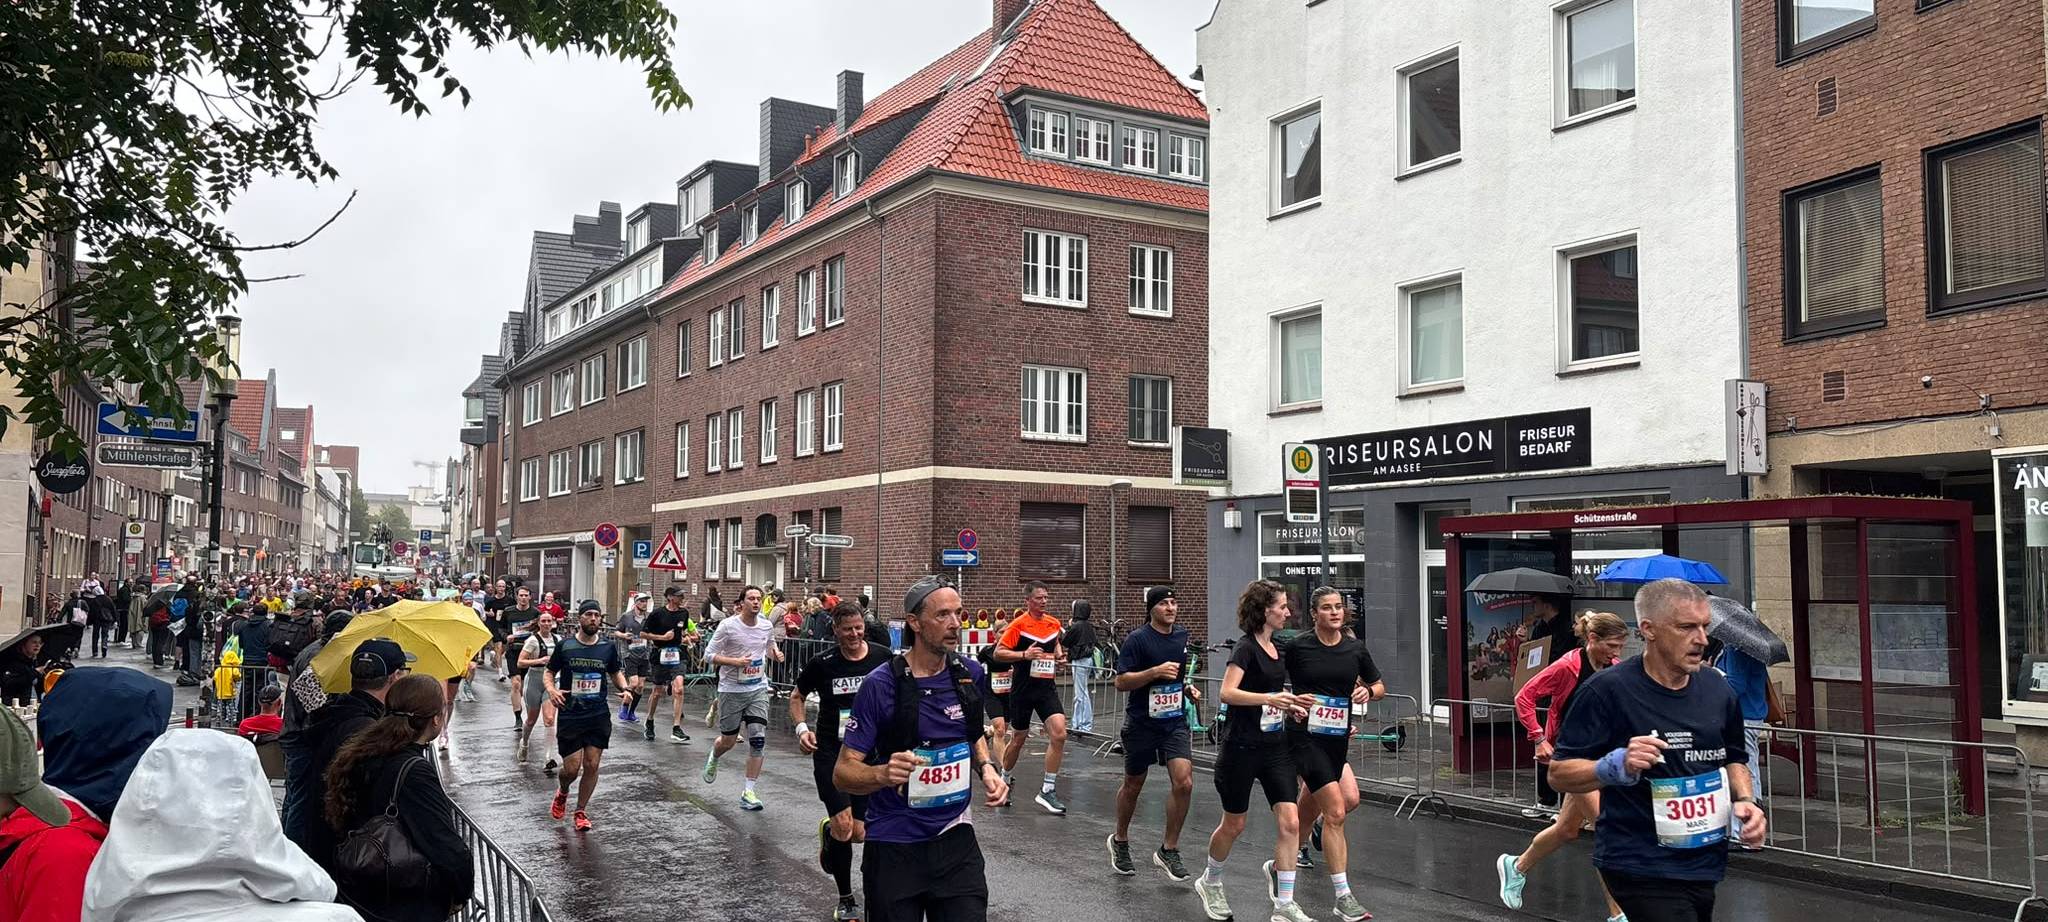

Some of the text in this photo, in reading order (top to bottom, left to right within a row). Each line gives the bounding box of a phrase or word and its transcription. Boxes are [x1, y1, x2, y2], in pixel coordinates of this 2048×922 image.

[1519, 425, 1576, 441] FRISEUR
[1327, 429, 1492, 465] RISEURSALON
[1519, 441, 1572, 456] BEDARF
[106, 450, 187, 464] Mühlenstraße
[1184, 467, 1225, 475] FRISEURSALON
[1373, 463, 1421, 475] AM AASEE
[1574, 512, 1638, 524] Schützenstraße
[1276, 526, 1355, 539] FRISEURALON
[1286, 566, 1338, 575] OHNE TERN!
[1572, 565, 1581, 574] N
[1584, 565, 1591, 574] &
[742, 666, 760, 675] 4604
[833, 677, 864, 688] KATP
[1154, 694, 1179, 705] 3316
[1316, 707, 1344, 720] 4754
[919, 763, 960, 784] 4831
[1666, 794, 1715, 820] 3031
